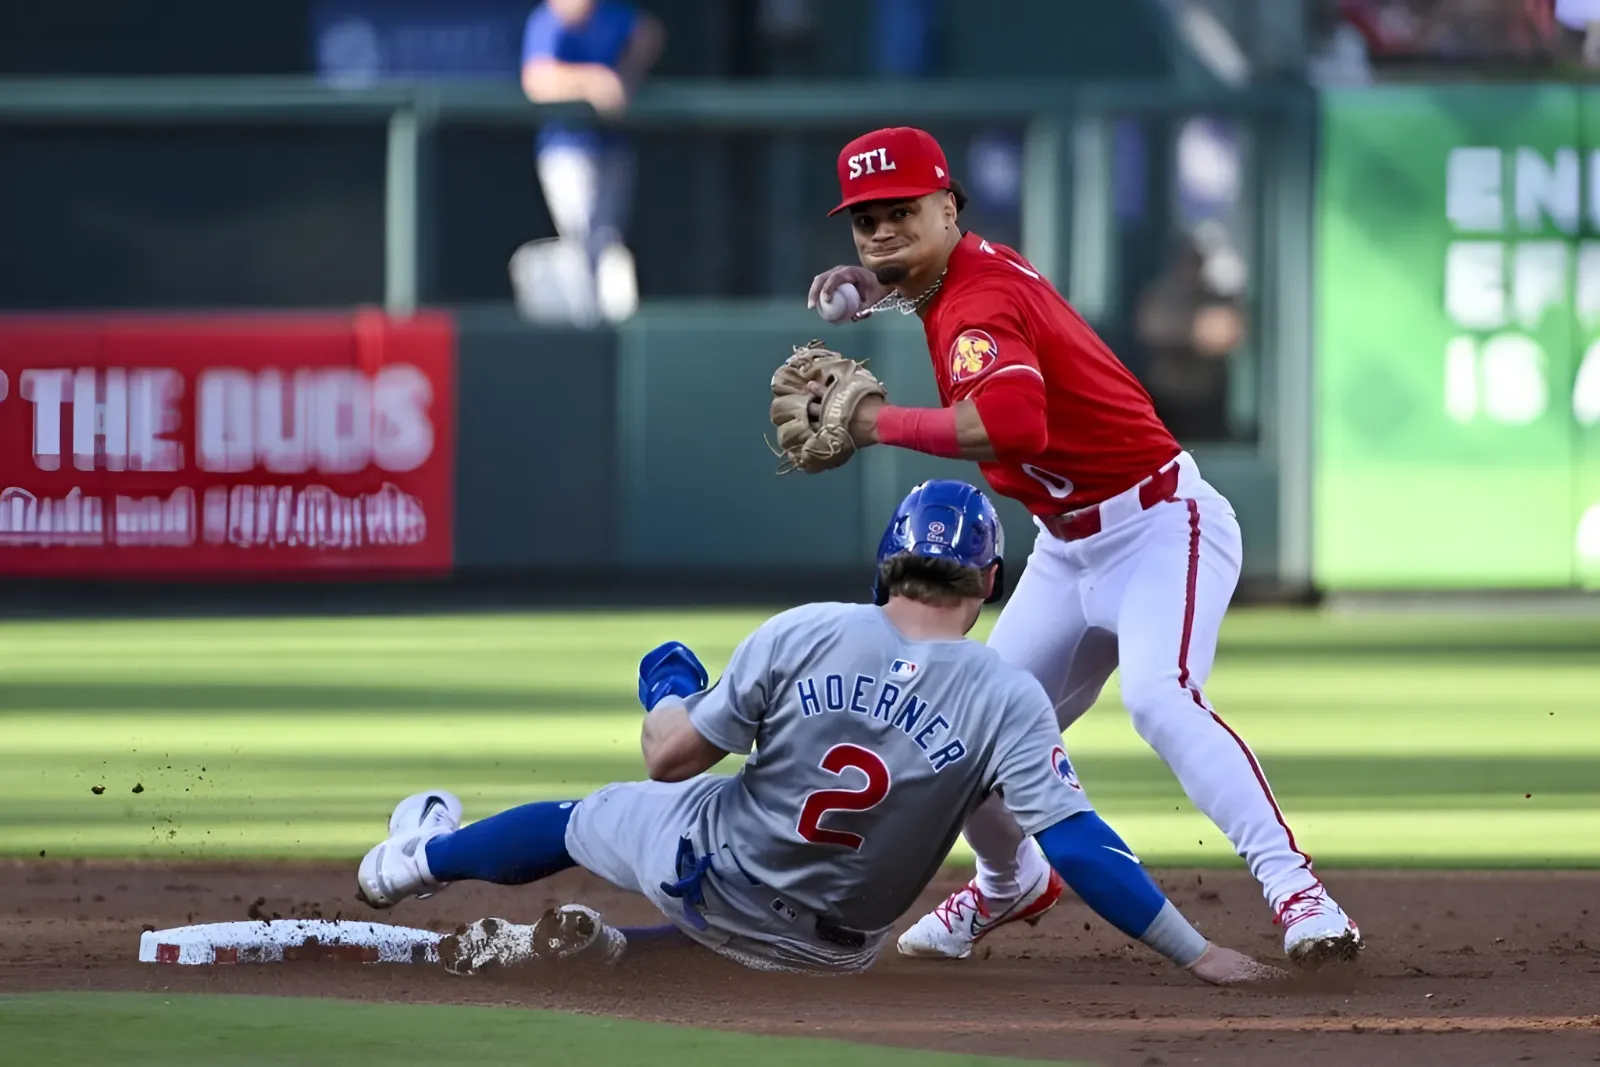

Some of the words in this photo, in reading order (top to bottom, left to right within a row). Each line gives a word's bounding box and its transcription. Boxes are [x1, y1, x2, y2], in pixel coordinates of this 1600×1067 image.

[848, 148, 896, 180] STL
[1446, 146, 1600, 233] EN
[20, 367, 185, 472] THE
[1021, 463, 1074, 499] 0
[796, 673, 968, 774] HOERNER
[797, 743, 891, 852] 2
